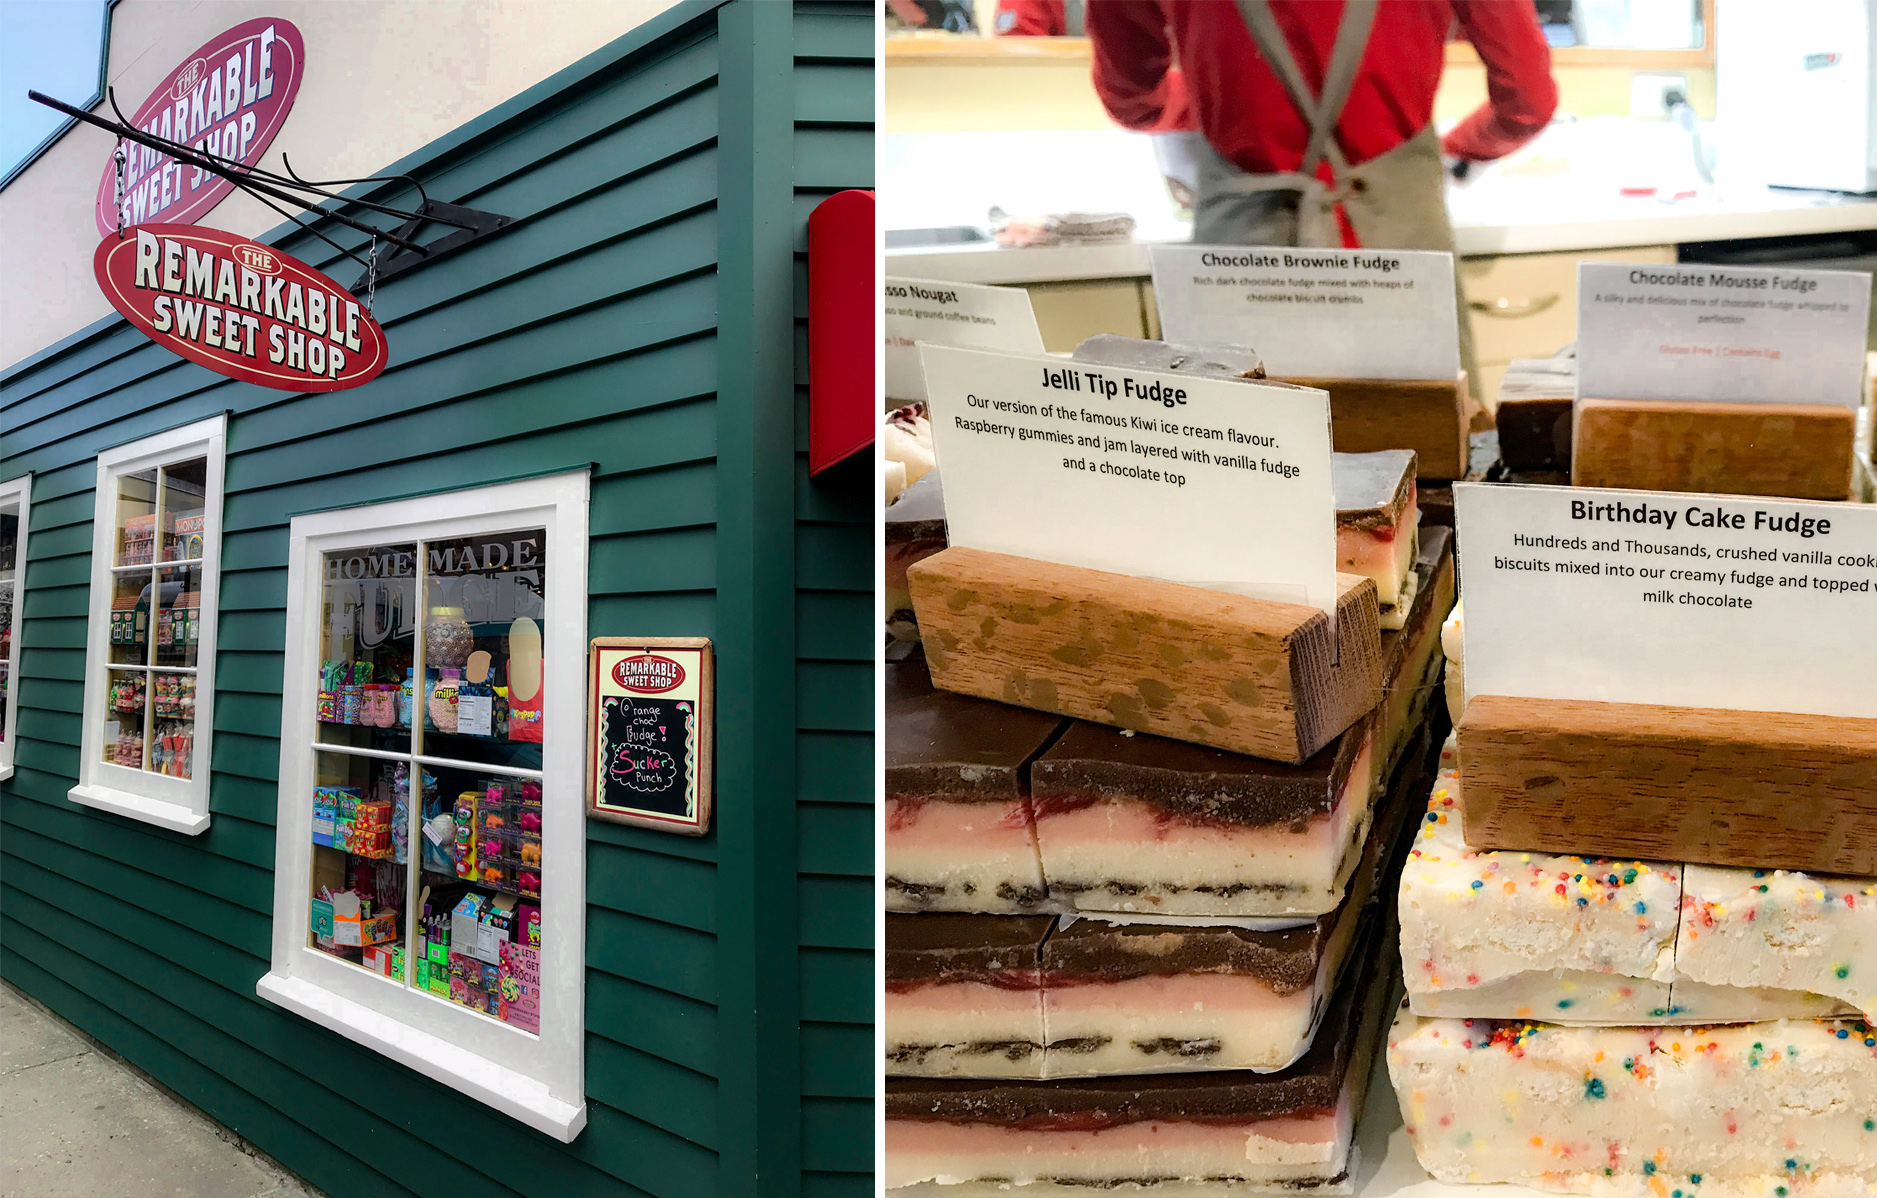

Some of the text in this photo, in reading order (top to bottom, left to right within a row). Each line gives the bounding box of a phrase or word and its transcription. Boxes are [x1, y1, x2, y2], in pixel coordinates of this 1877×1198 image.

[177, 62, 199, 95] THE
[121, 111, 257, 229] SWEET SHOP
[242, 250, 272, 270] THE
[1201, 253, 1400, 273] Chocolate Brownie Fudge
[134, 229, 362, 353] REMARKABLE
[1239, 276, 1286, 287] chocolate
[1288, 278, 1315, 289] fudge
[1318, 278, 1347, 288] mixed
[1350, 278, 1371, 289] with
[1373, 279, 1401, 291] heaps
[1403, 280, 1414, 290] of
[1629, 270, 1818, 293] Chocolate Mousse Fudge
[885, 285, 959, 304] sso Nougat
[1246, 293, 1292, 303] chocolate
[152, 295, 346, 380] SWEET SHOP
[1042, 368, 1188, 407] Jelli Tip Fudge
[967, 394, 1280, 449] Our version of the famous Kiwi ice cream flavour.
[955, 416, 1300, 479] Raspberry gummies and jam layered with vanilla fudge
[1063, 457, 1186, 487] and a chocolate top
[1571, 500, 1831, 538] Birthday Cake Fudge
[325, 539, 538, 580] HOME MADE
[1514, 533, 1588, 550] Hundreds
[1592, 539, 1620, 552] and
[1625, 540, 1711, 560] Thousands,
[1716, 547, 1778, 562] crushed
[1782, 551, 1832, 565] vanilla
[1494, 556, 1551, 572] biscuits
[1555, 561, 1601, 575] mixed
[1605, 563, 1635, 577] into
[1639, 568, 1666, 579] our
[1670, 569, 1727, 586] creamy
[1731, 570, 1775, 588] fudge
[1779, 575, 1808, 588] and
[1813, 576, 1870, 593] topped
[1643, 590, 1753, 609] milk chocolate
[619, 662, 678, 679] REMARKABLE
[623, 675, 673, 689] SWEET SHOP
[620, 697, 662, 722] Orange
[633, 717, 655, 726] choc
[636, 771, 663, 783] Punch
[521, 947, 537, 960] LETS
[525, 960, 540, 972] GET
[513, 970, 541, 987] SOCIAL
